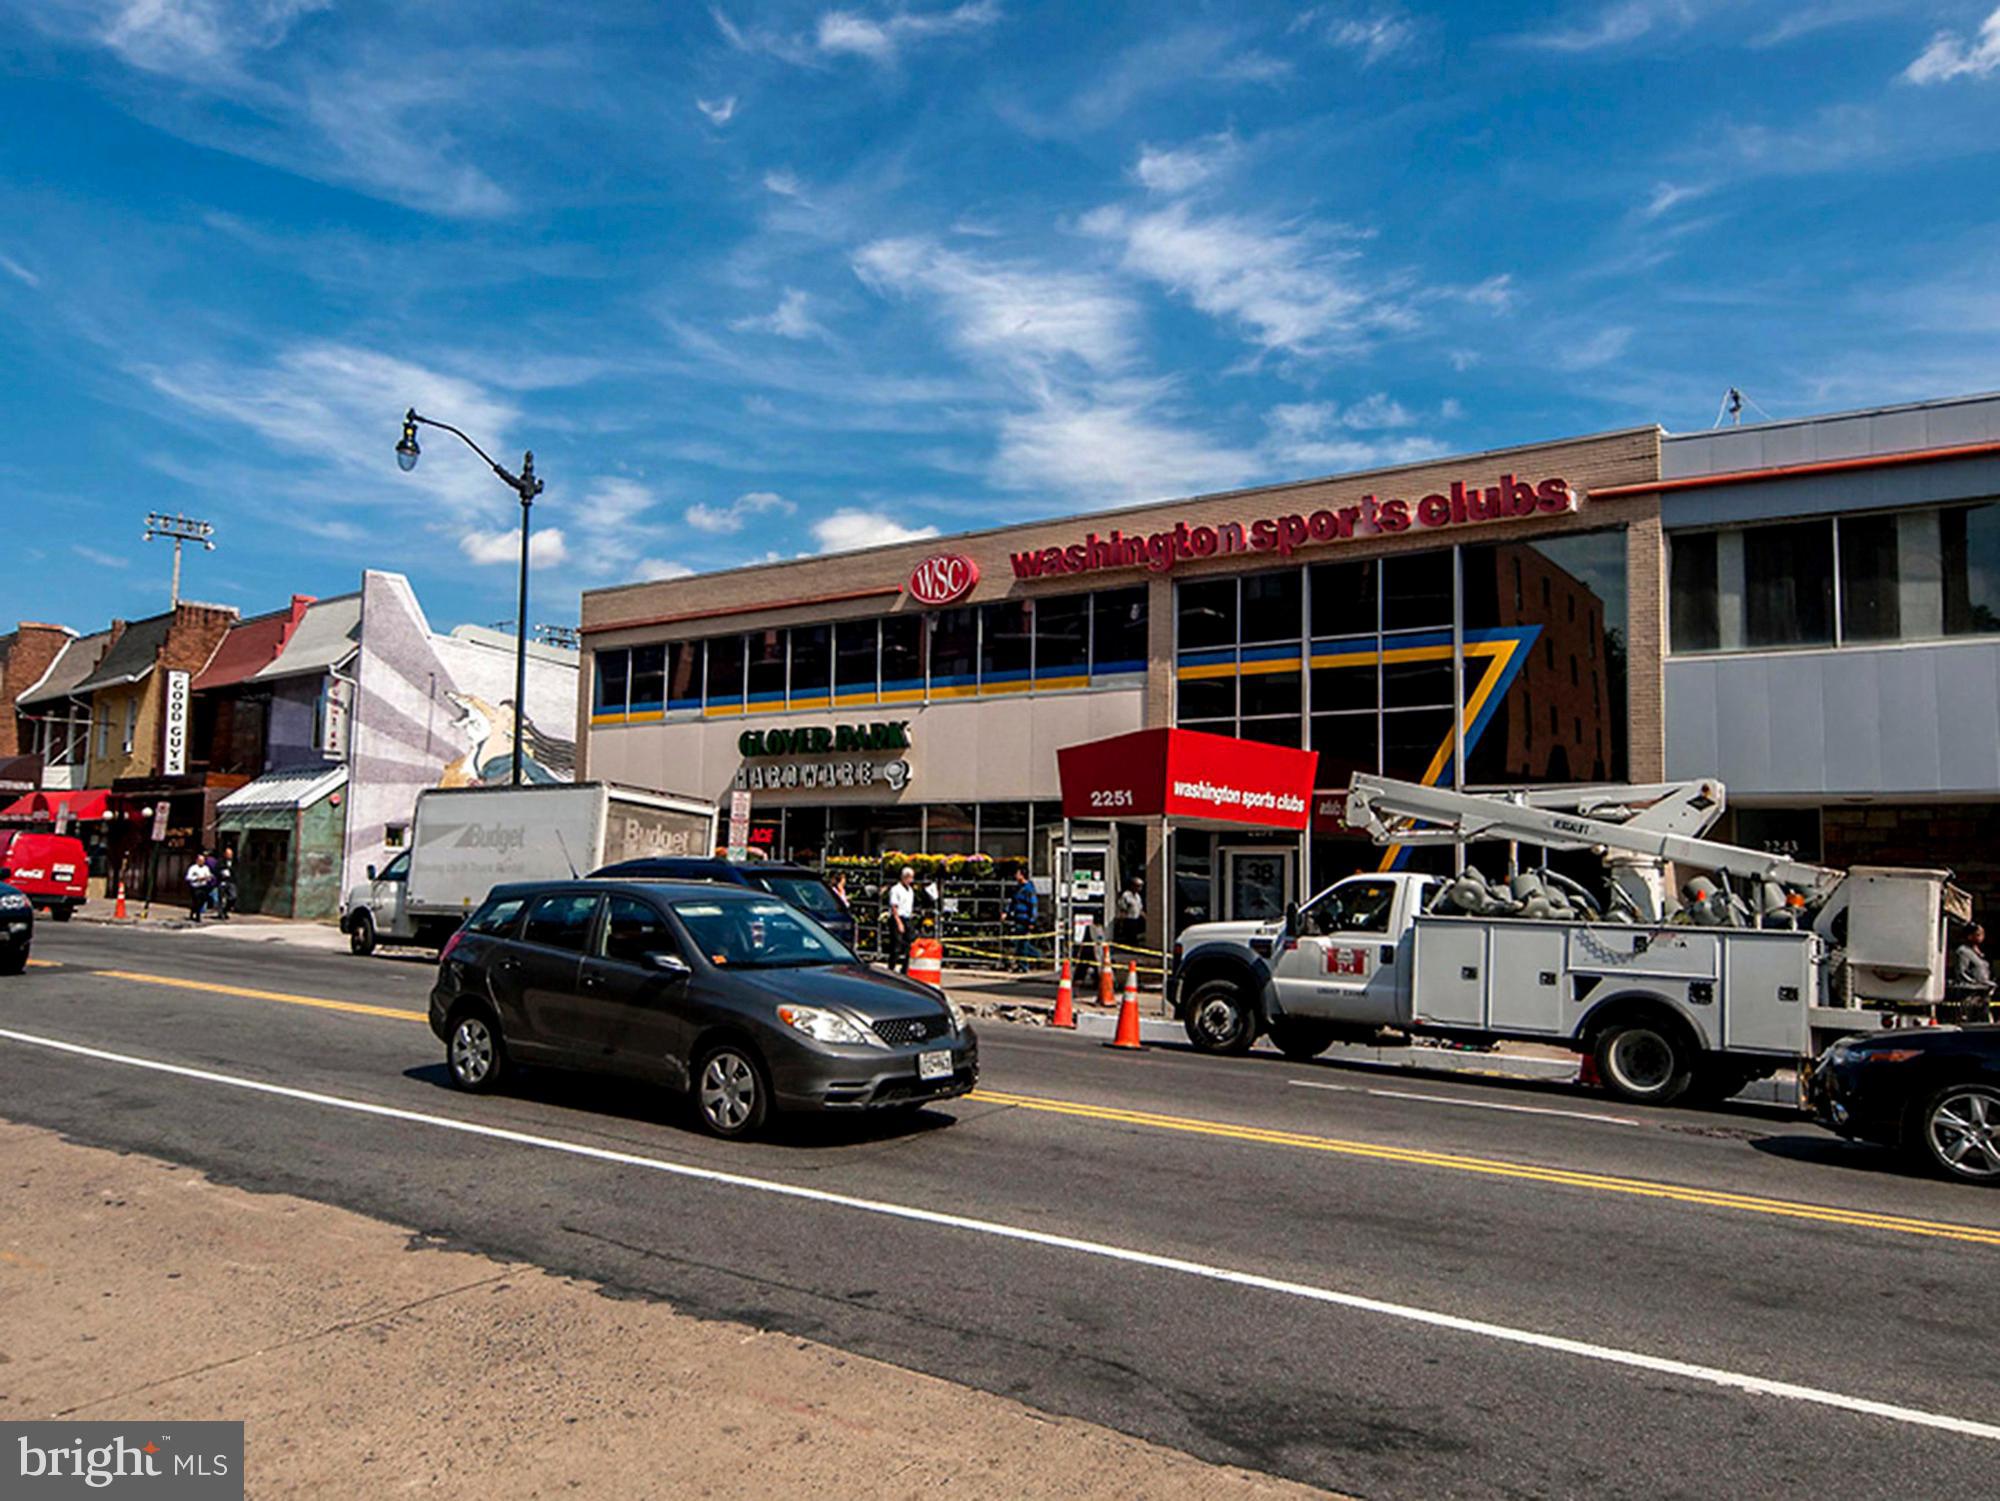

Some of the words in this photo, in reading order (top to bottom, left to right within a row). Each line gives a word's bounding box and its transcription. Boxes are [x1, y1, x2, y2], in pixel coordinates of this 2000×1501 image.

[1010, 520, 1247, 574] washington
[1250, 494, 1412, 556] sports
[1417, 474, 1571, 527] clubs
[917, 558, 963, 600] WSC
[171, 680, 183, 721] GOOD
[169, 727, 182, 771] GUYS
[738, 727, 834, 757] GLOVER
[835, 720, 911, 750] PARK
[734, 760, 875, 790] HARDWARE
[1090, 789, 1134, 807] 2251
[1173, 780, 1241, 805] washington
[1242, 791, 1276, 809] sports
[1276, 795, 1305, 812] clubs
[468, 822, 525, 854] Budget
[624, 817, 691, 852] Budget
